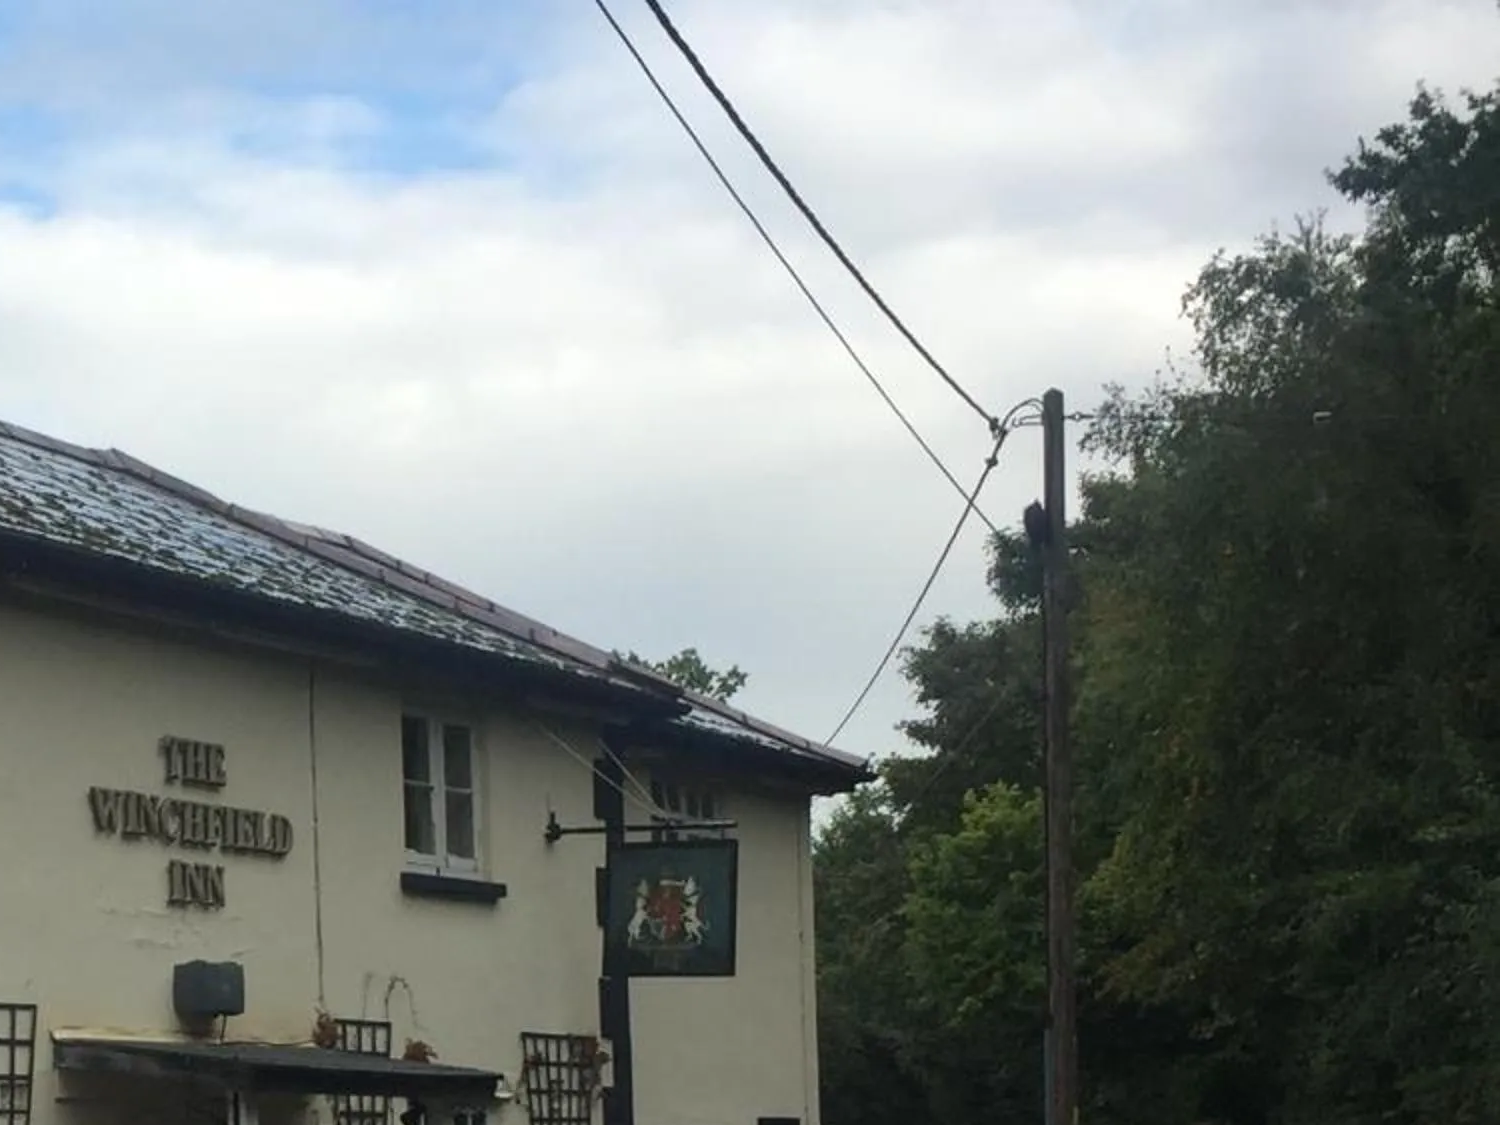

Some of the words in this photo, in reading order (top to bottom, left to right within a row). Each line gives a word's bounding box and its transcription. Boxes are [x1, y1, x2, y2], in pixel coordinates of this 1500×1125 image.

[158, 735, 227, 791] THE
[88, 785, 294, 862] WINCHFIELD
[166, 859, 225, 909] INN
